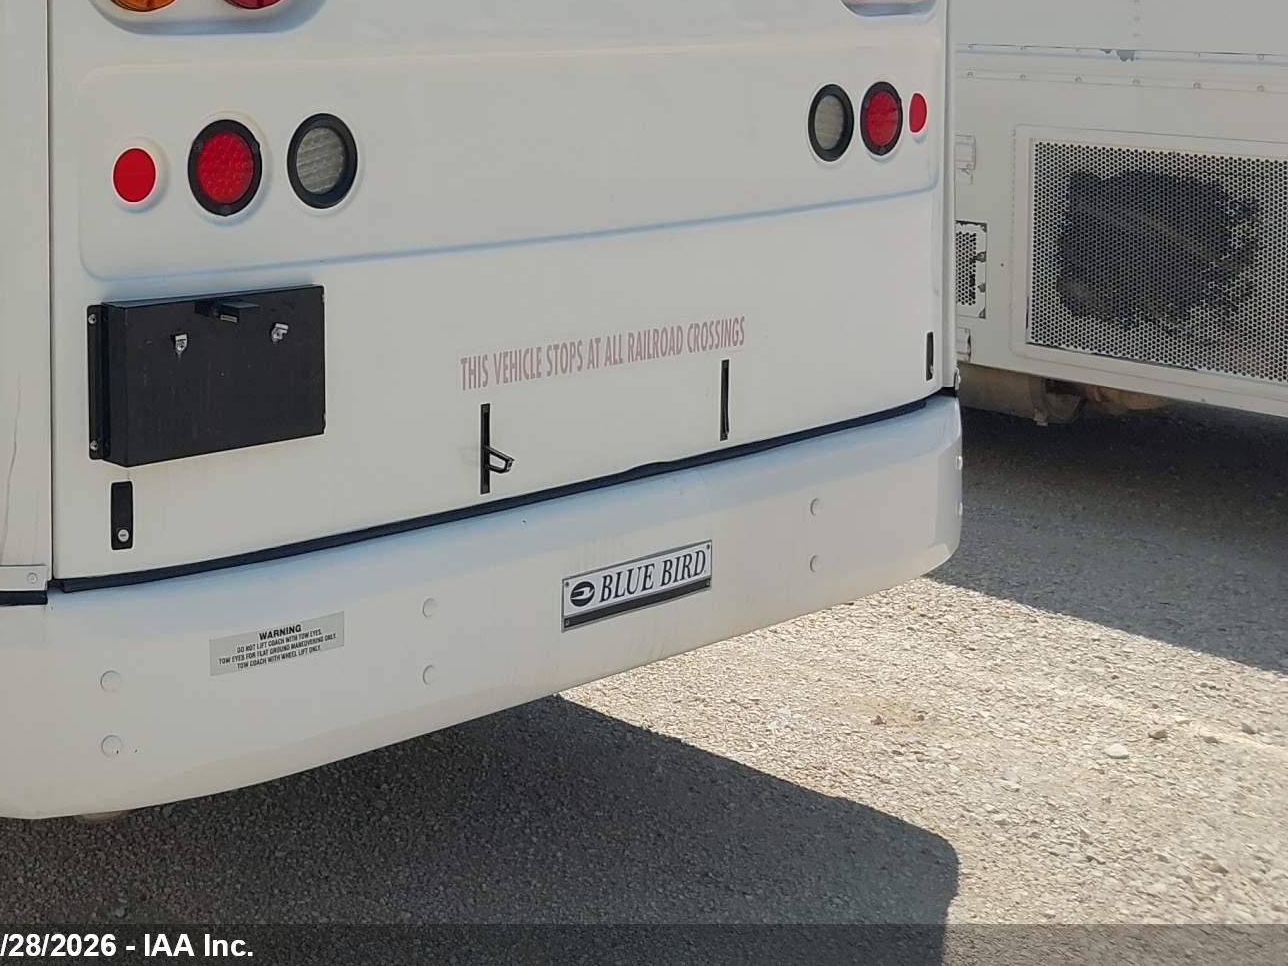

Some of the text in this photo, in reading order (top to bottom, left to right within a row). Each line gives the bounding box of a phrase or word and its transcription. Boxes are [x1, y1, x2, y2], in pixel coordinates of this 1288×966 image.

[460, 315, 746, 391] THIS VEHICLE STOPS AT ALL RAILROAD CROSSINGS
[599, 549, 707, 603] BLUE BIRD
[236, 645, 245, 654] DO
[245, 643, 256, 653] NOT
[256, 641, 267, 650] LIFT
[268, 637, 284, 648] COACH
[285, 634, 298, 644] WITH
[299, 631, 310, 640] TOW
[258, 624, 302, 641] WARNING
[218, 657, 231, 666] TOW
[232, 654, 245, 663] EYES
[245, 651, 256, 661] FOR
[257, 648, 269, 658] FLAT
[269, 644, 291, 656] GROUND
[237, 661, 249, 670] TOW
[249, 657, 267, 667] COACH
[267, 653, 281, 663] WITH
[281, 650, 298, 660] WHEEL
[298, 647, 309, 656] LIFT
